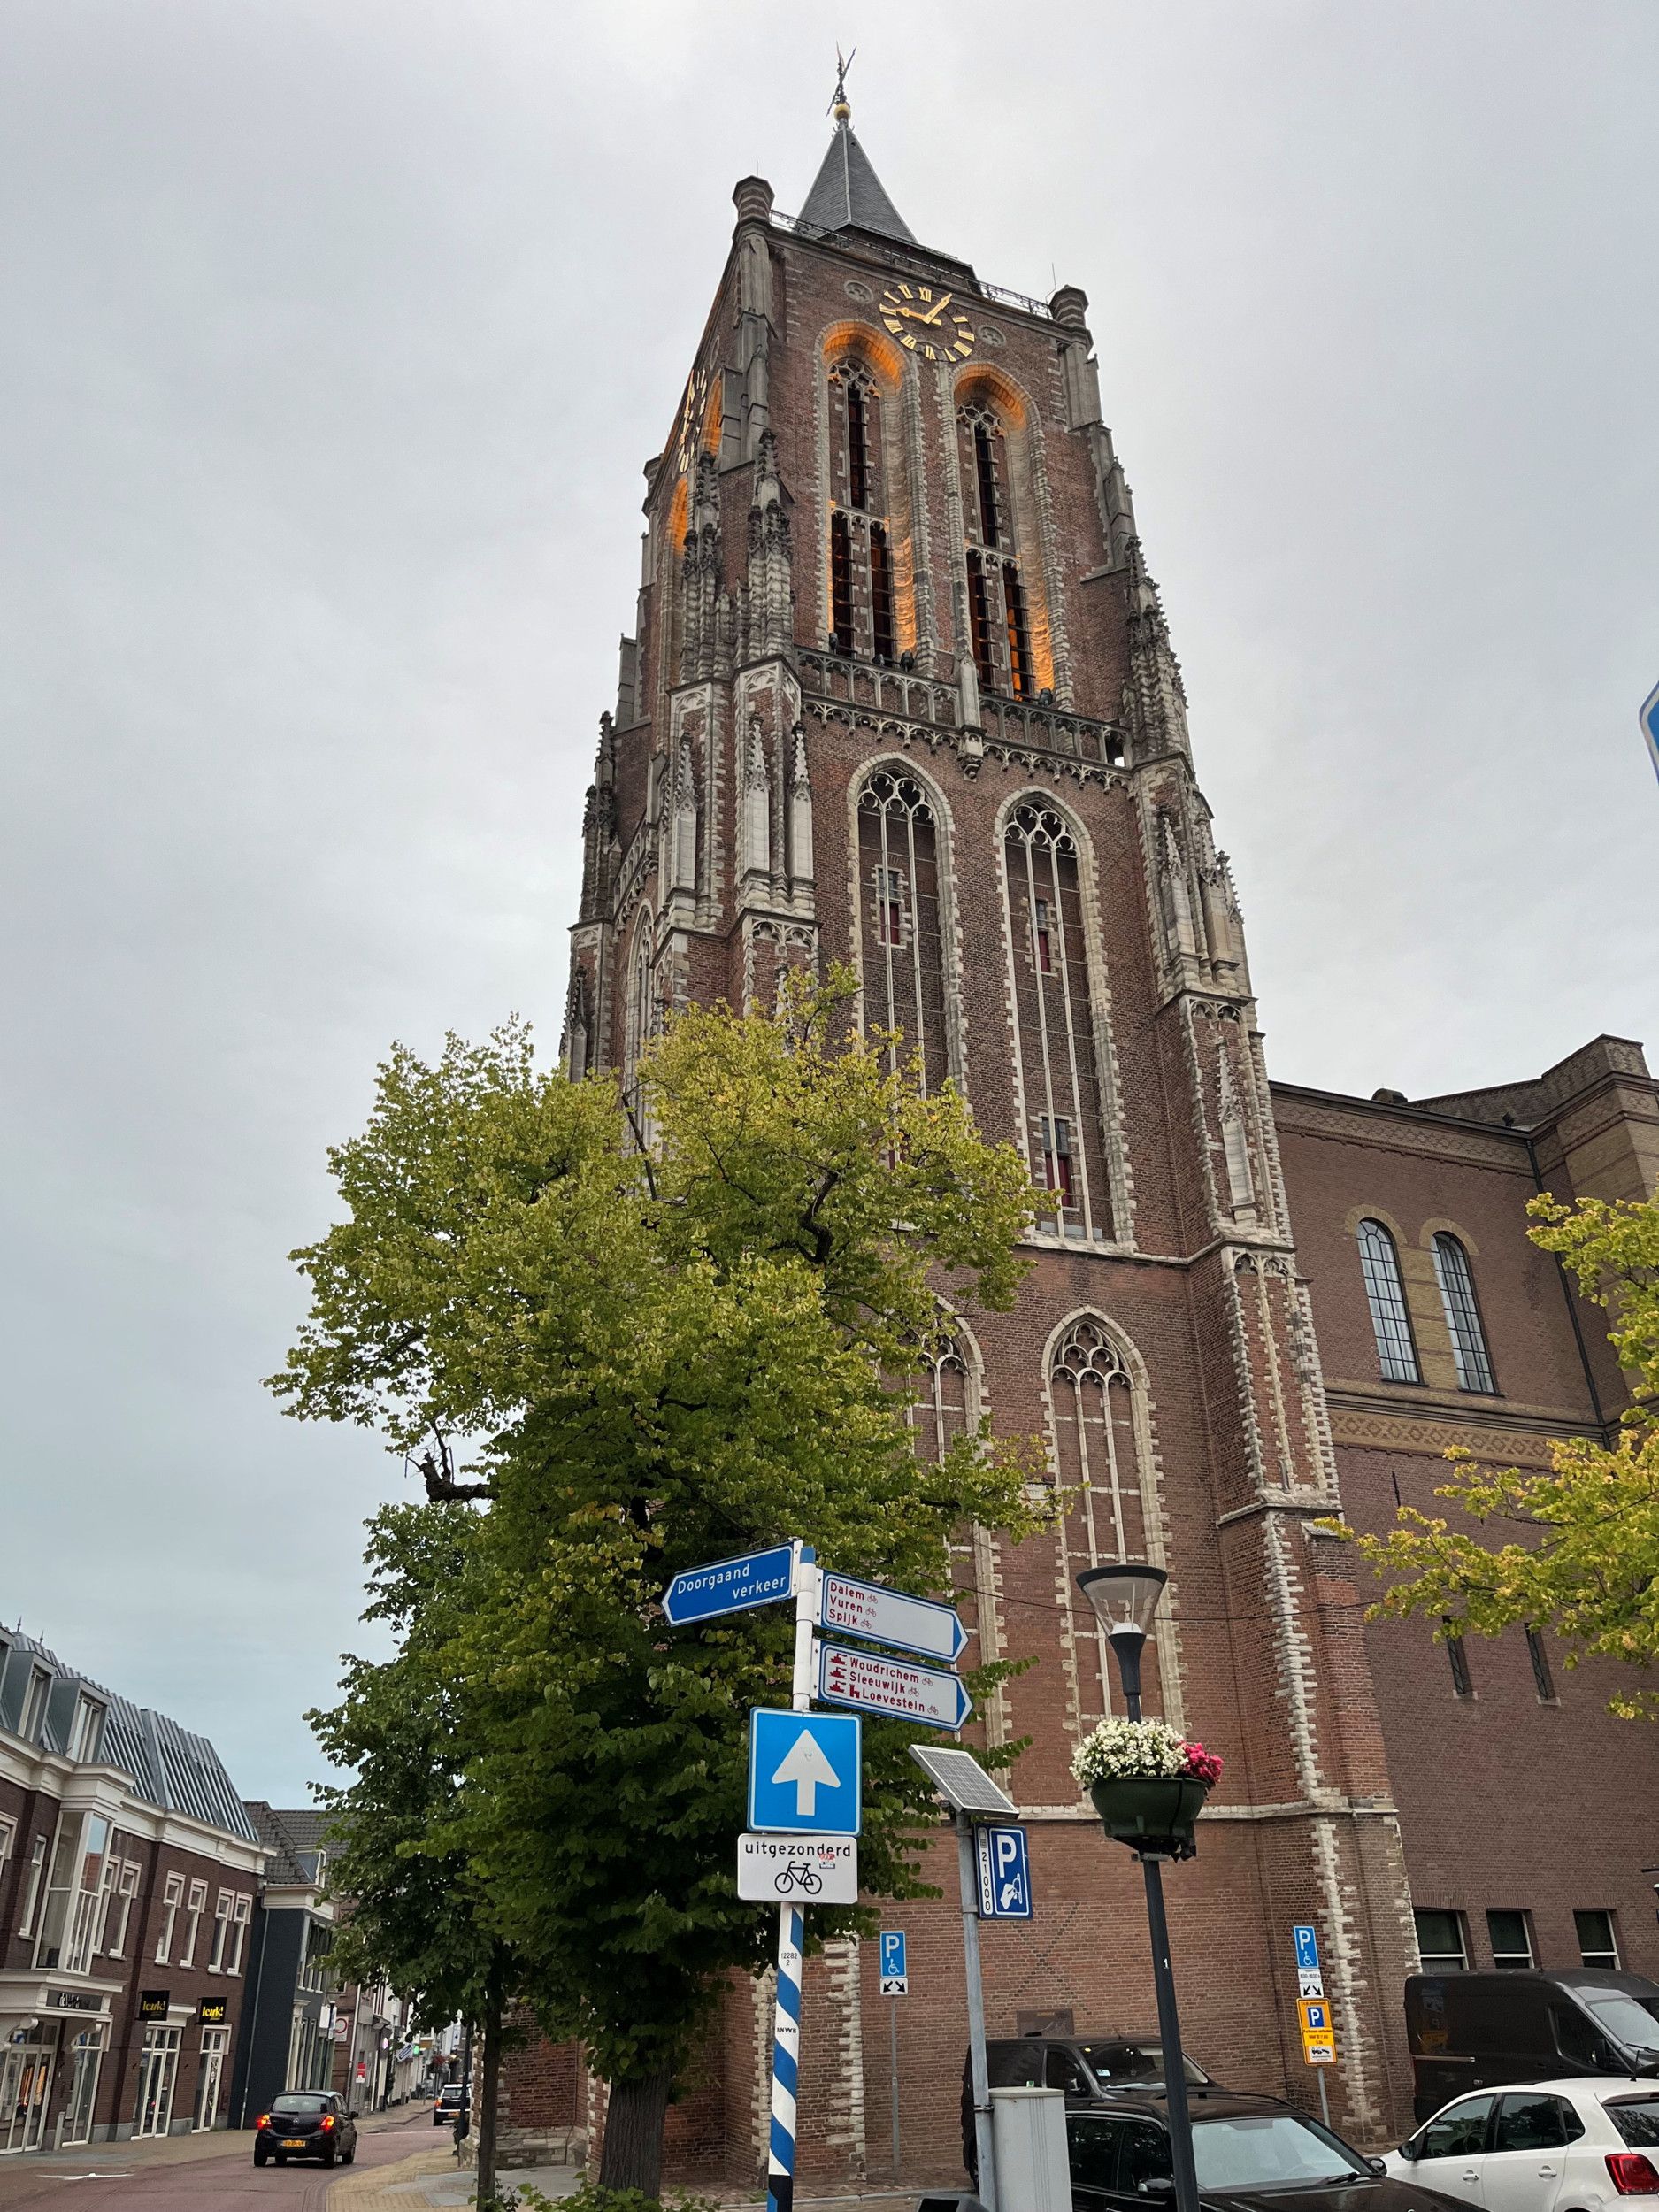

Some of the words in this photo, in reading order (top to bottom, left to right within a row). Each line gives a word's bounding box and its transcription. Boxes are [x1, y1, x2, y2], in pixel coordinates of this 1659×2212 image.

[678, 1563, 749, 1594] Doorgaand
[732, 1576, 787, 1600] verkeer
[830, 1581, 864, 1601] Dalem
[830, 1594, 863, 1613] Vuren
[829, 1609, 857, 1626] Spijk
[850, 1657, 919, 1684] Woudrichem
[849, 1671, 906, 1695] Sleeuwijk
[863, 1688, 925, 1713] Loevestein
[745, 1841, 850, 1858] uitgezonderd
[996, 1834, 1017, 1878] P
[886, 1935, 900, 1958] P
[1298, 1930, 1310, 1951] P
[1310, 2008, 1320, 2025] P
